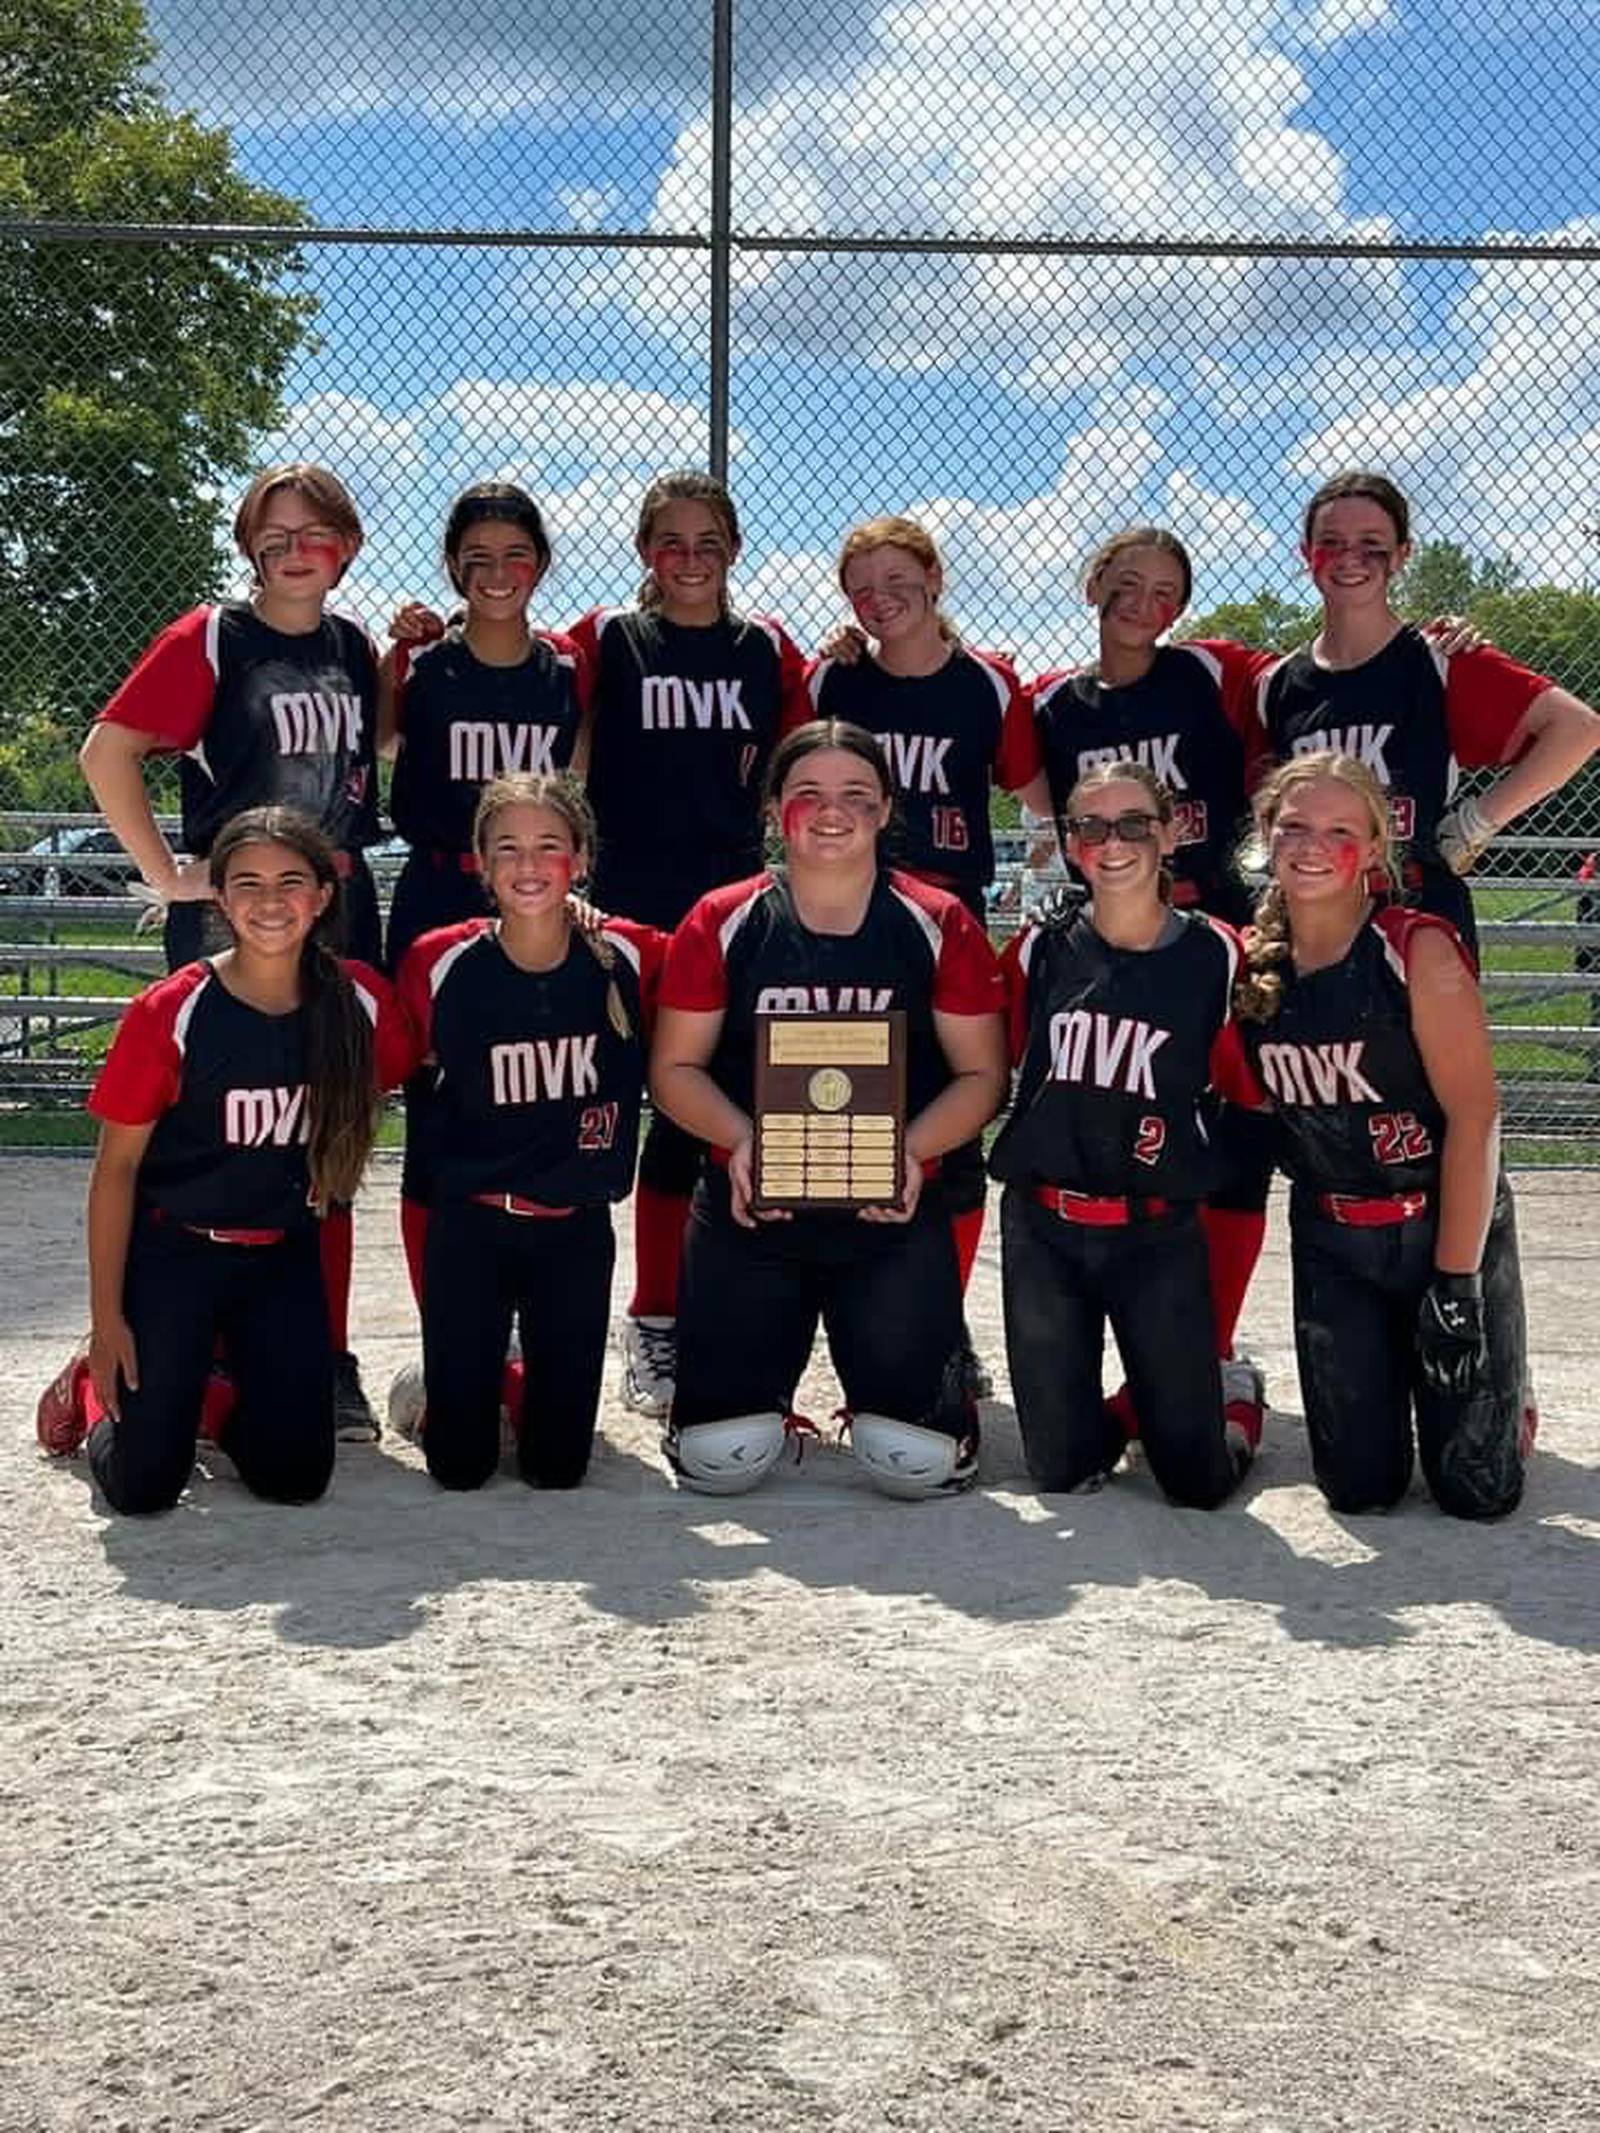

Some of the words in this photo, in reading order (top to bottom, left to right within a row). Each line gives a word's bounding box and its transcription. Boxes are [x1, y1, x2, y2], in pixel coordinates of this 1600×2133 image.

[641, 675, 753, 730] MVK
[450, 721, 560, 780] MVK
[873, 731, 953, 795] VK
[931, 803, 969, 851] 16
[491, 1033, 599, 1106] MVK
[1047, 1009, 1171, 1100] MVK
[1258, 1041, 1383, 1106] MVK
[578, 1102, 618, 1150] 21
[1134, 1115, 1166, 1166] 2
[1368, 1111, 1433, 1166] 22
